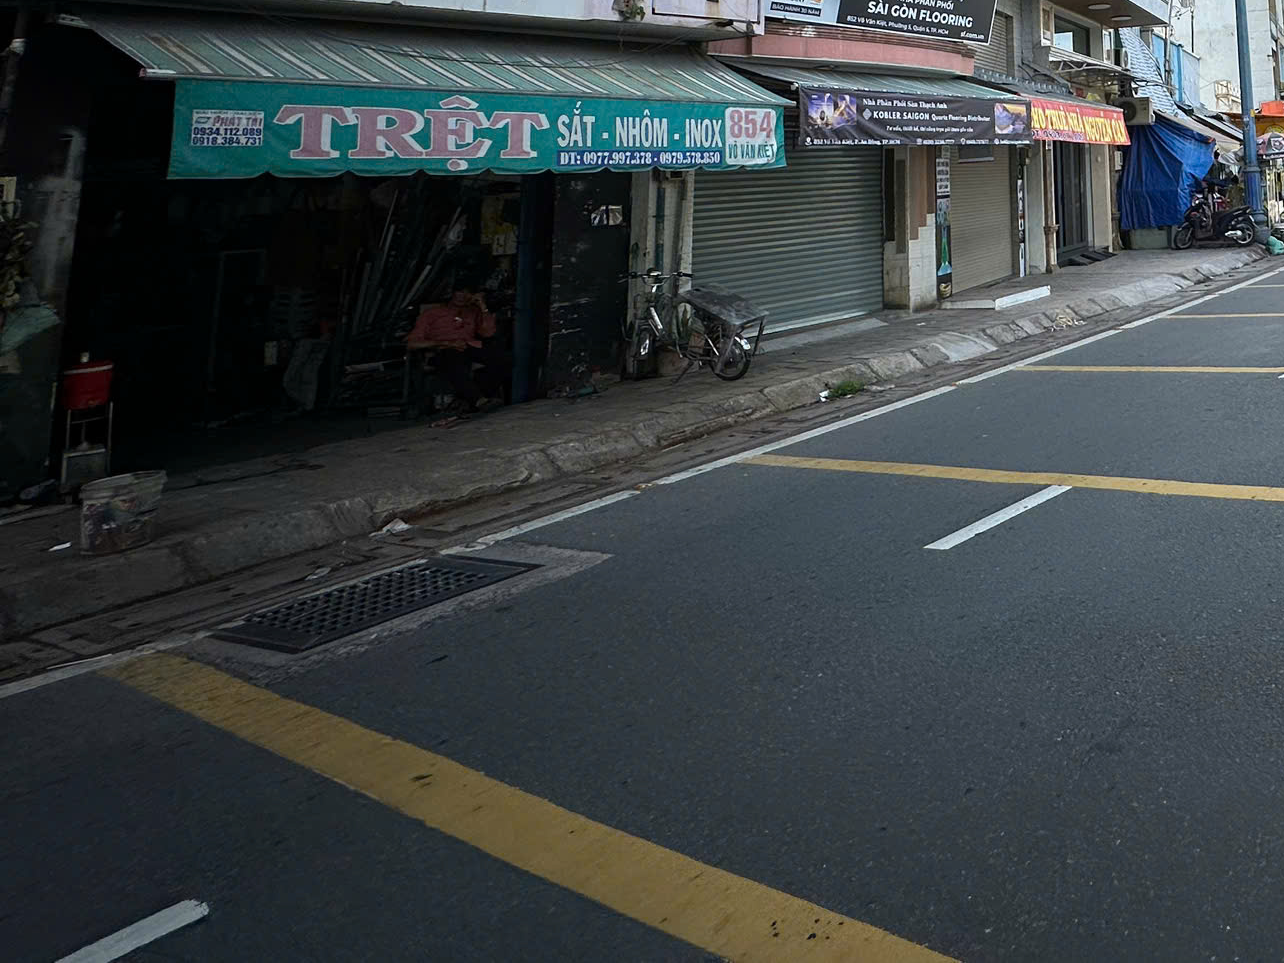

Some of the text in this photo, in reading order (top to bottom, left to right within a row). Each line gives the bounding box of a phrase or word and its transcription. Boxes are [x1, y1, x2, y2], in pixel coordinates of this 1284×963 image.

[936, 0, 954, 10] PHỐI
[866, 17, 876, 25] Văn
[867, 0, 973, 28] SÀI GÒN FLOORING
[863, 98, 876, 106] Nhà
[919, 101, 936, 109] Thạch
[873, 110, 901, 119] KOBLER
[903, 111, 930, 120] SAIGON
[931, 113, 948, 121] Quartz
[1031, 107, 1046, 129] HO
[557, 101, 595, 148] SẮT
[615, 109, 668, 148] NHÔM
[685, 118, 723, 148] INOX
[729, 109, 773, 139] 854
[193, 127, 262, 137] 0934.112.089
[273, 94, 550, 172] TRỆT
[192, 137, 261, 146] 0918.384.731
[583, 150, 652, 165] 0977.997.378
[660, 150, 720, 164] 0979.578.850
[728, 140, 776, 161] VÕ VĂN KIỆT
